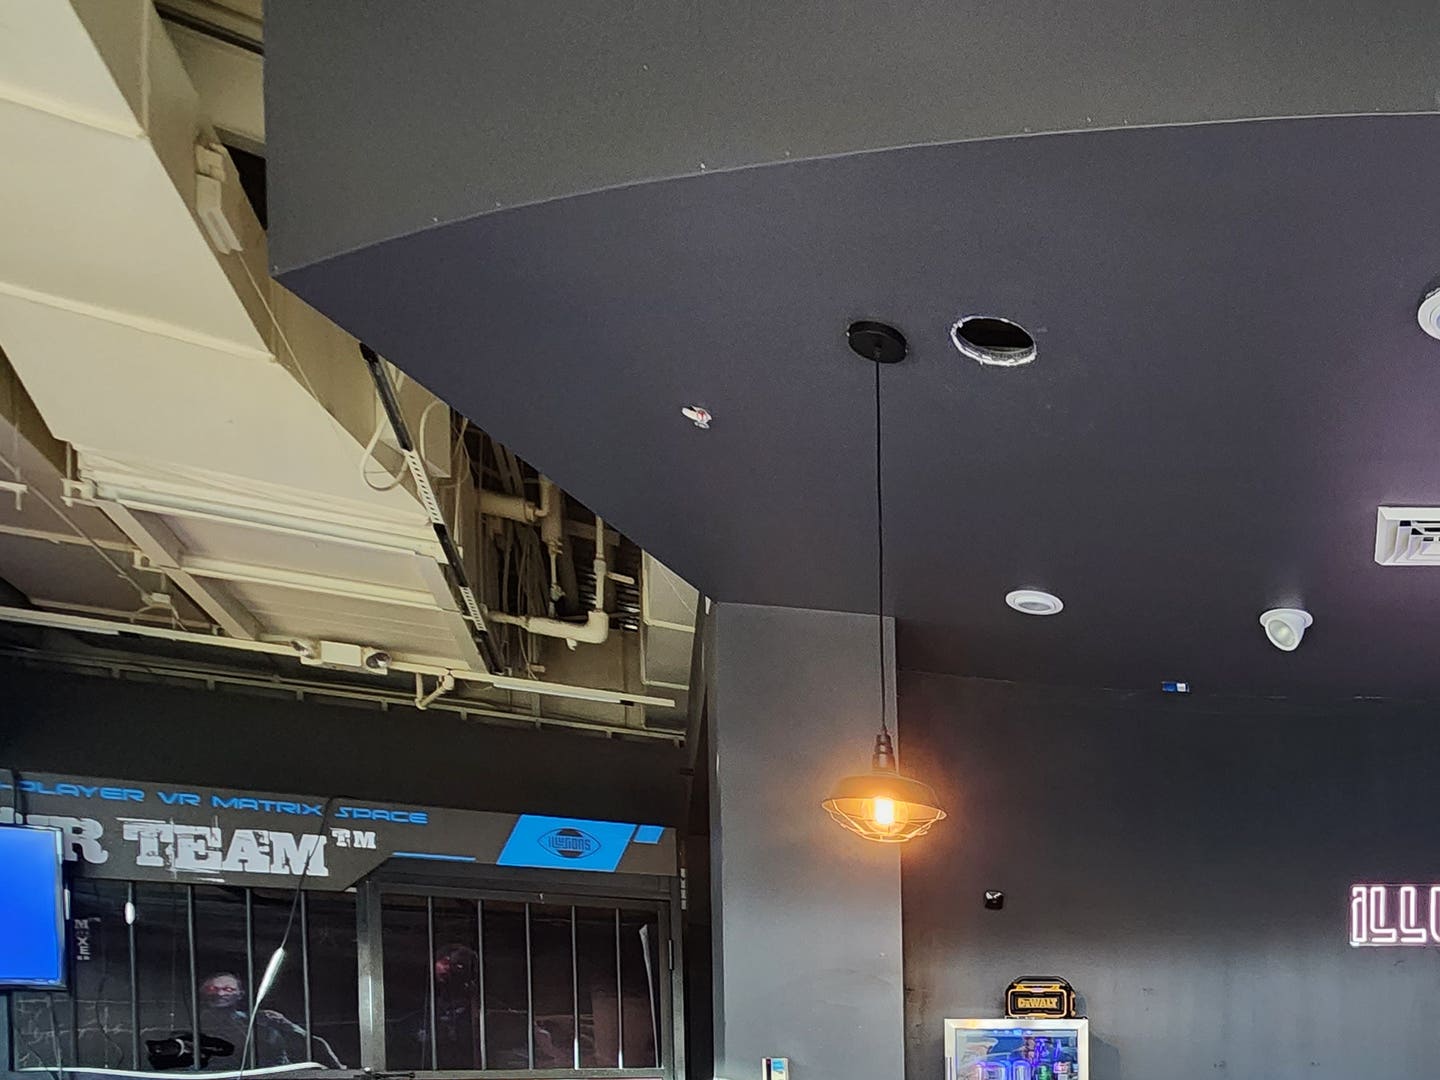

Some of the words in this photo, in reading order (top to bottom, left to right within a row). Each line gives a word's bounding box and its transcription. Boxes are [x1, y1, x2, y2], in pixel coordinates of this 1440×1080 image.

[157, 791, 201, 806] VR
[211, 795, 324, 817] MATRIX
[334, 806, 429, 825] SPACE
